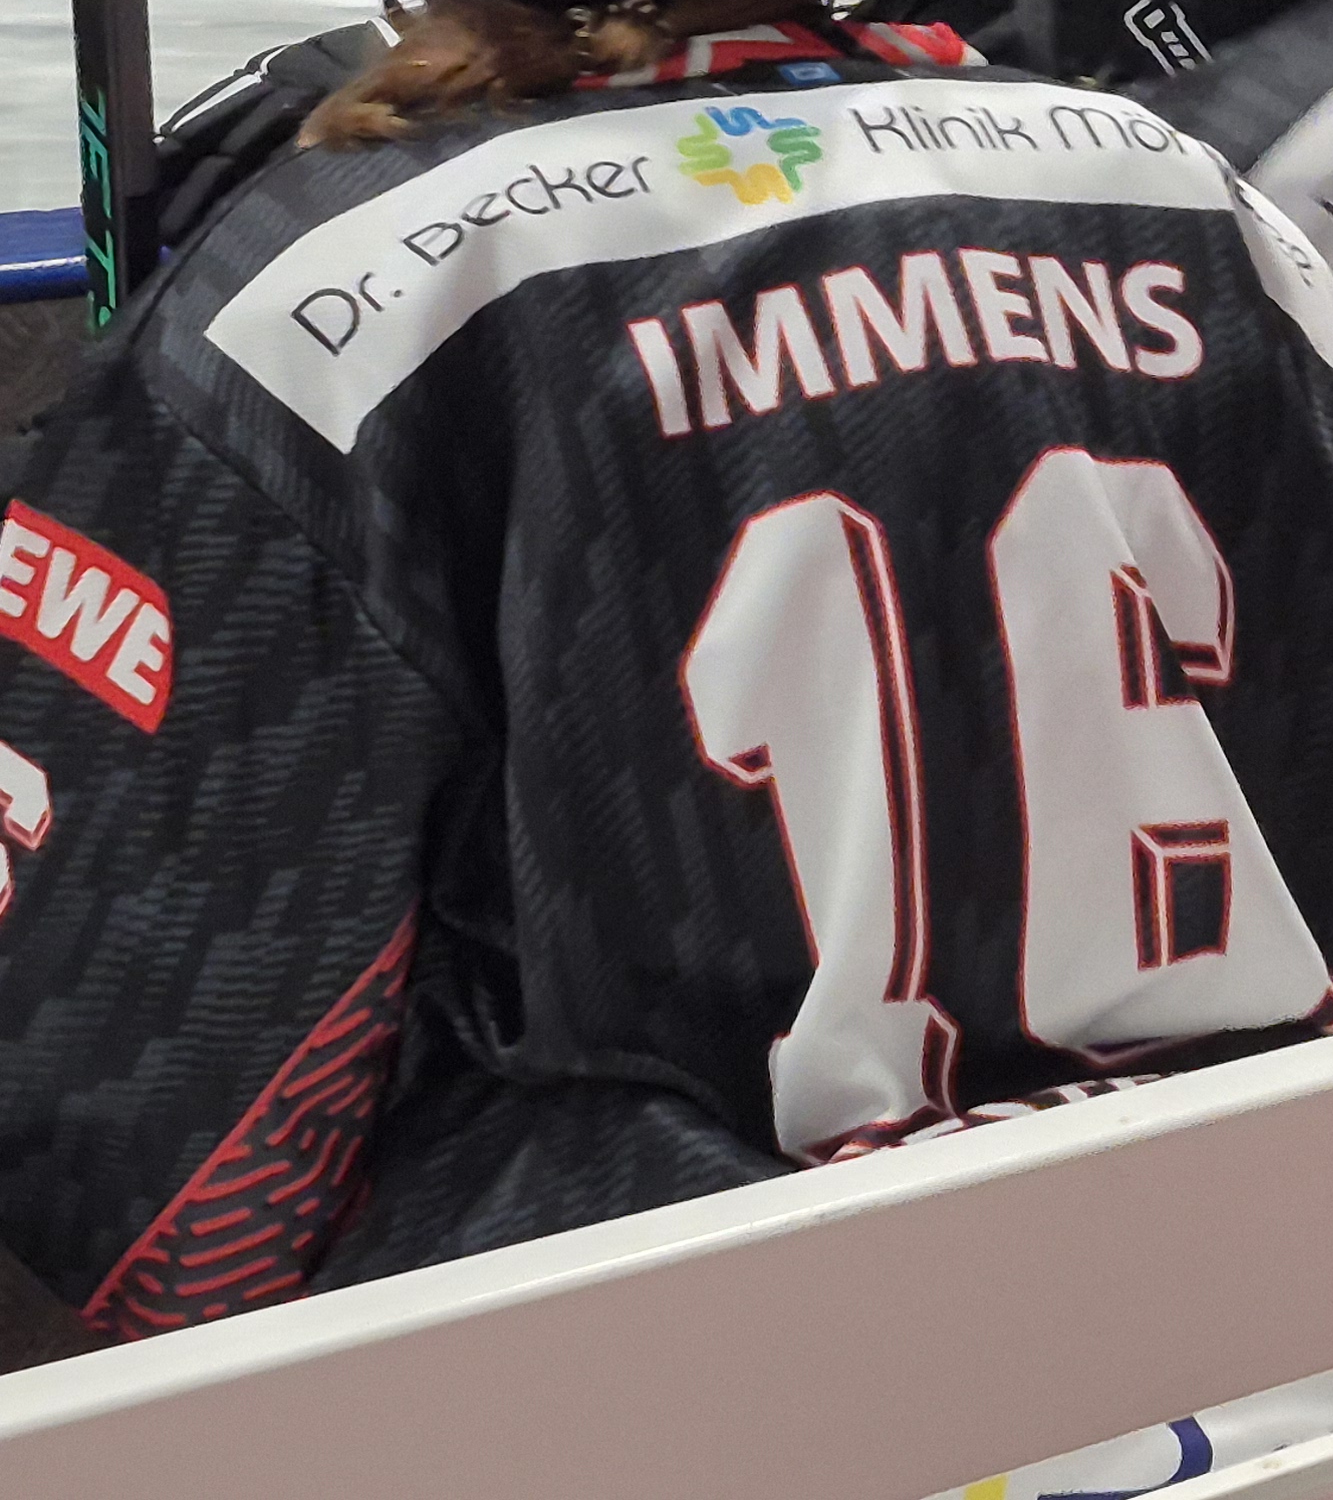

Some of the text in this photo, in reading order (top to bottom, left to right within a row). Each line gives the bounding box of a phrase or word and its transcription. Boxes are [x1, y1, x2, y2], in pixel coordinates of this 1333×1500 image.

[291, 270, 404, 357] Dr.
[402, 155, 651, 267] Becker
[850, 106, 1038, 153] Klinik
[627, 245, 1204, 441] IMMENS
